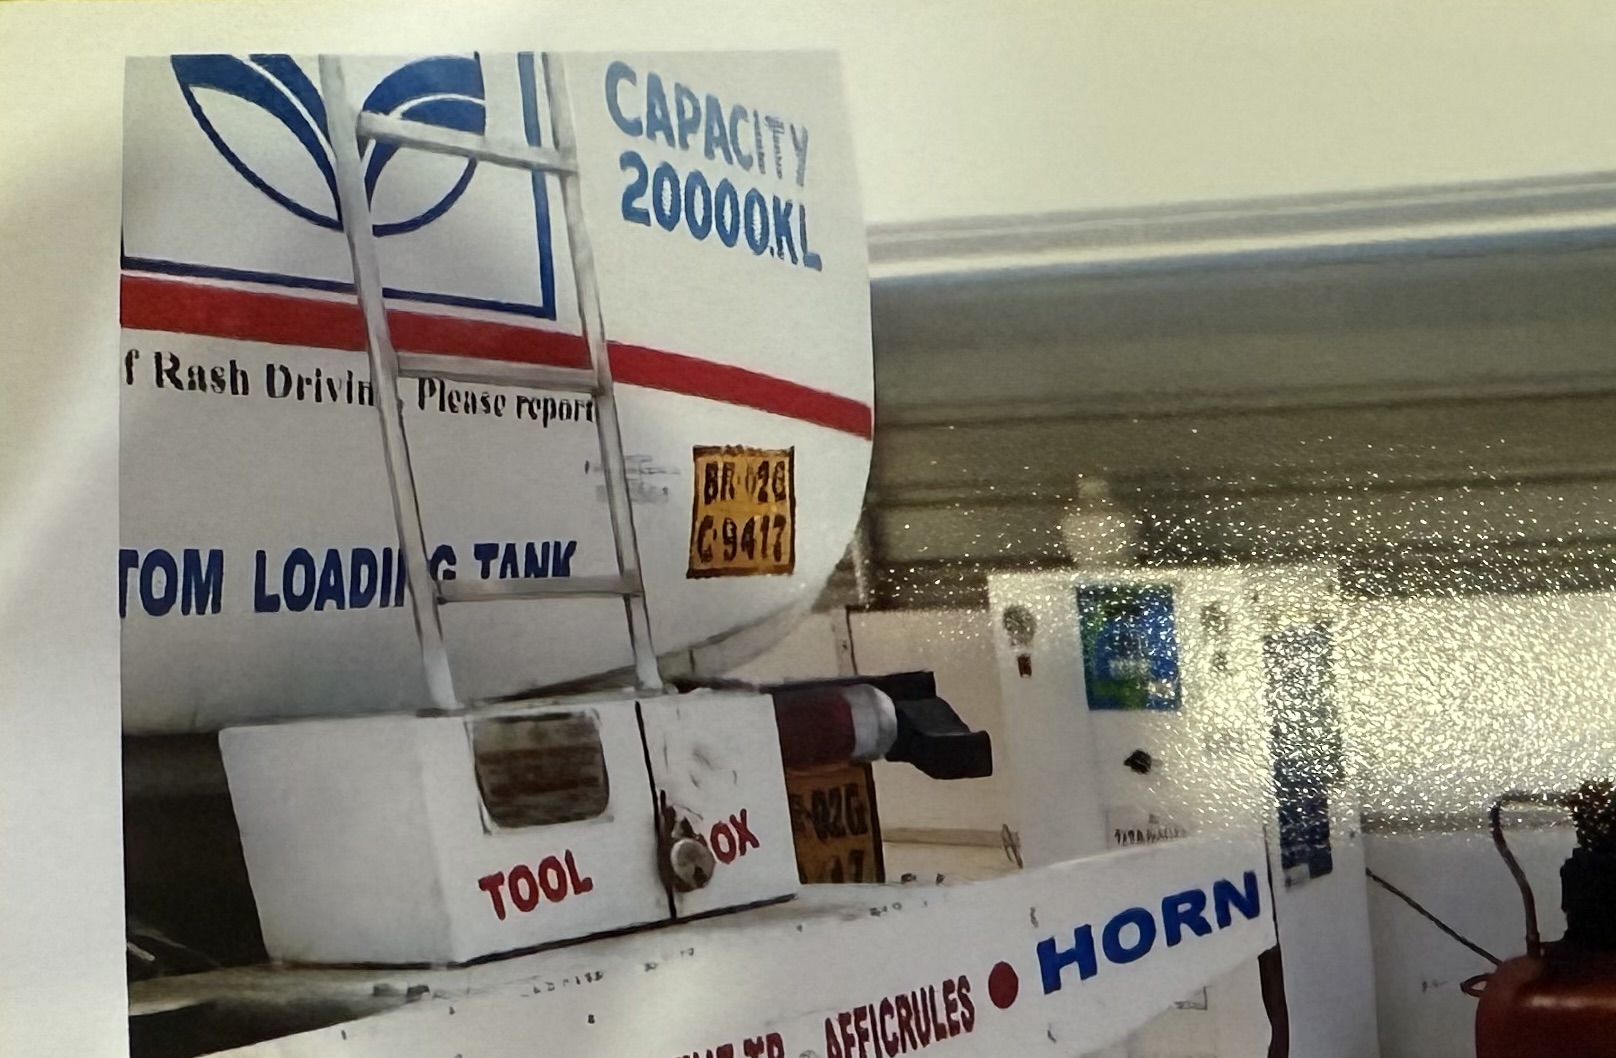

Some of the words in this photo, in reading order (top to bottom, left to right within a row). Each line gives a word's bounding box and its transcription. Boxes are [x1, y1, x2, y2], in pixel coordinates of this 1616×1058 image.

[605, 60, 809, 188] CAPACITY
[154, 351, 250, 396] Rash
[265, 363, 377, 407] Drivin
[417, 377, 506, 418] Please
[473, 540, 578, 580] TANK
[478, 849, 594, 921] TOOL
[709, 808, 761, 865] OX
[1036, 870, 1261, 996] HORN
